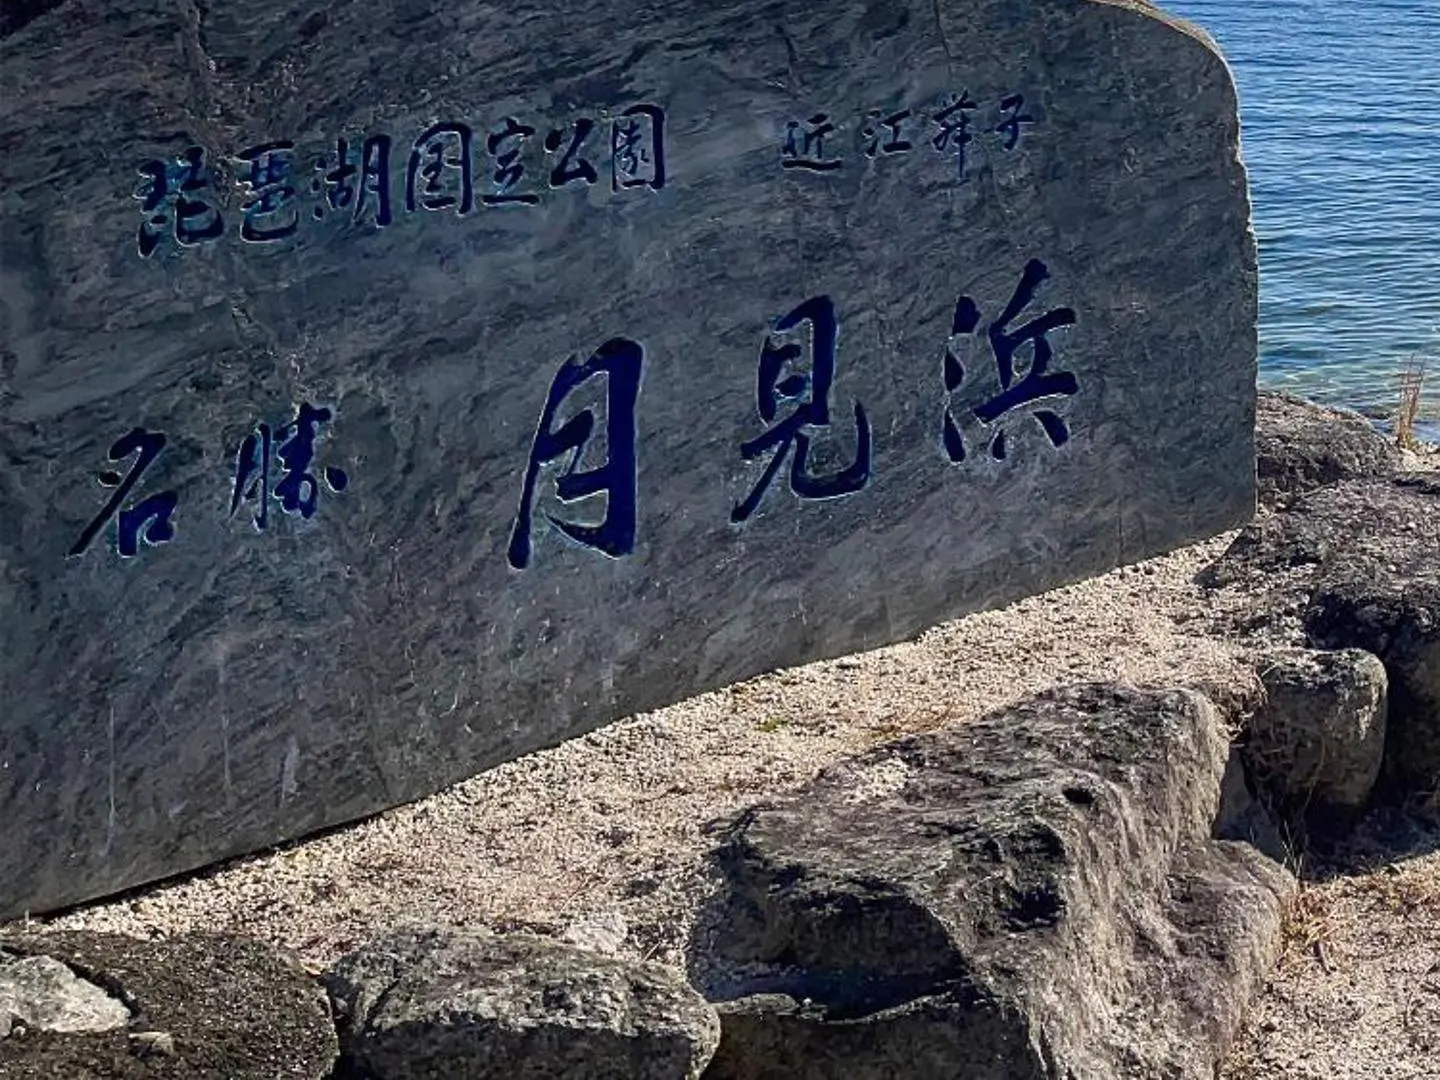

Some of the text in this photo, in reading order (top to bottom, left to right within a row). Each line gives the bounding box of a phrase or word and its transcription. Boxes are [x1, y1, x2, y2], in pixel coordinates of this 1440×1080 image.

[134, 104, 667, 258] 琵琶湖国立公園
[64, 258, 1078, 569] 名勝 月見浜
